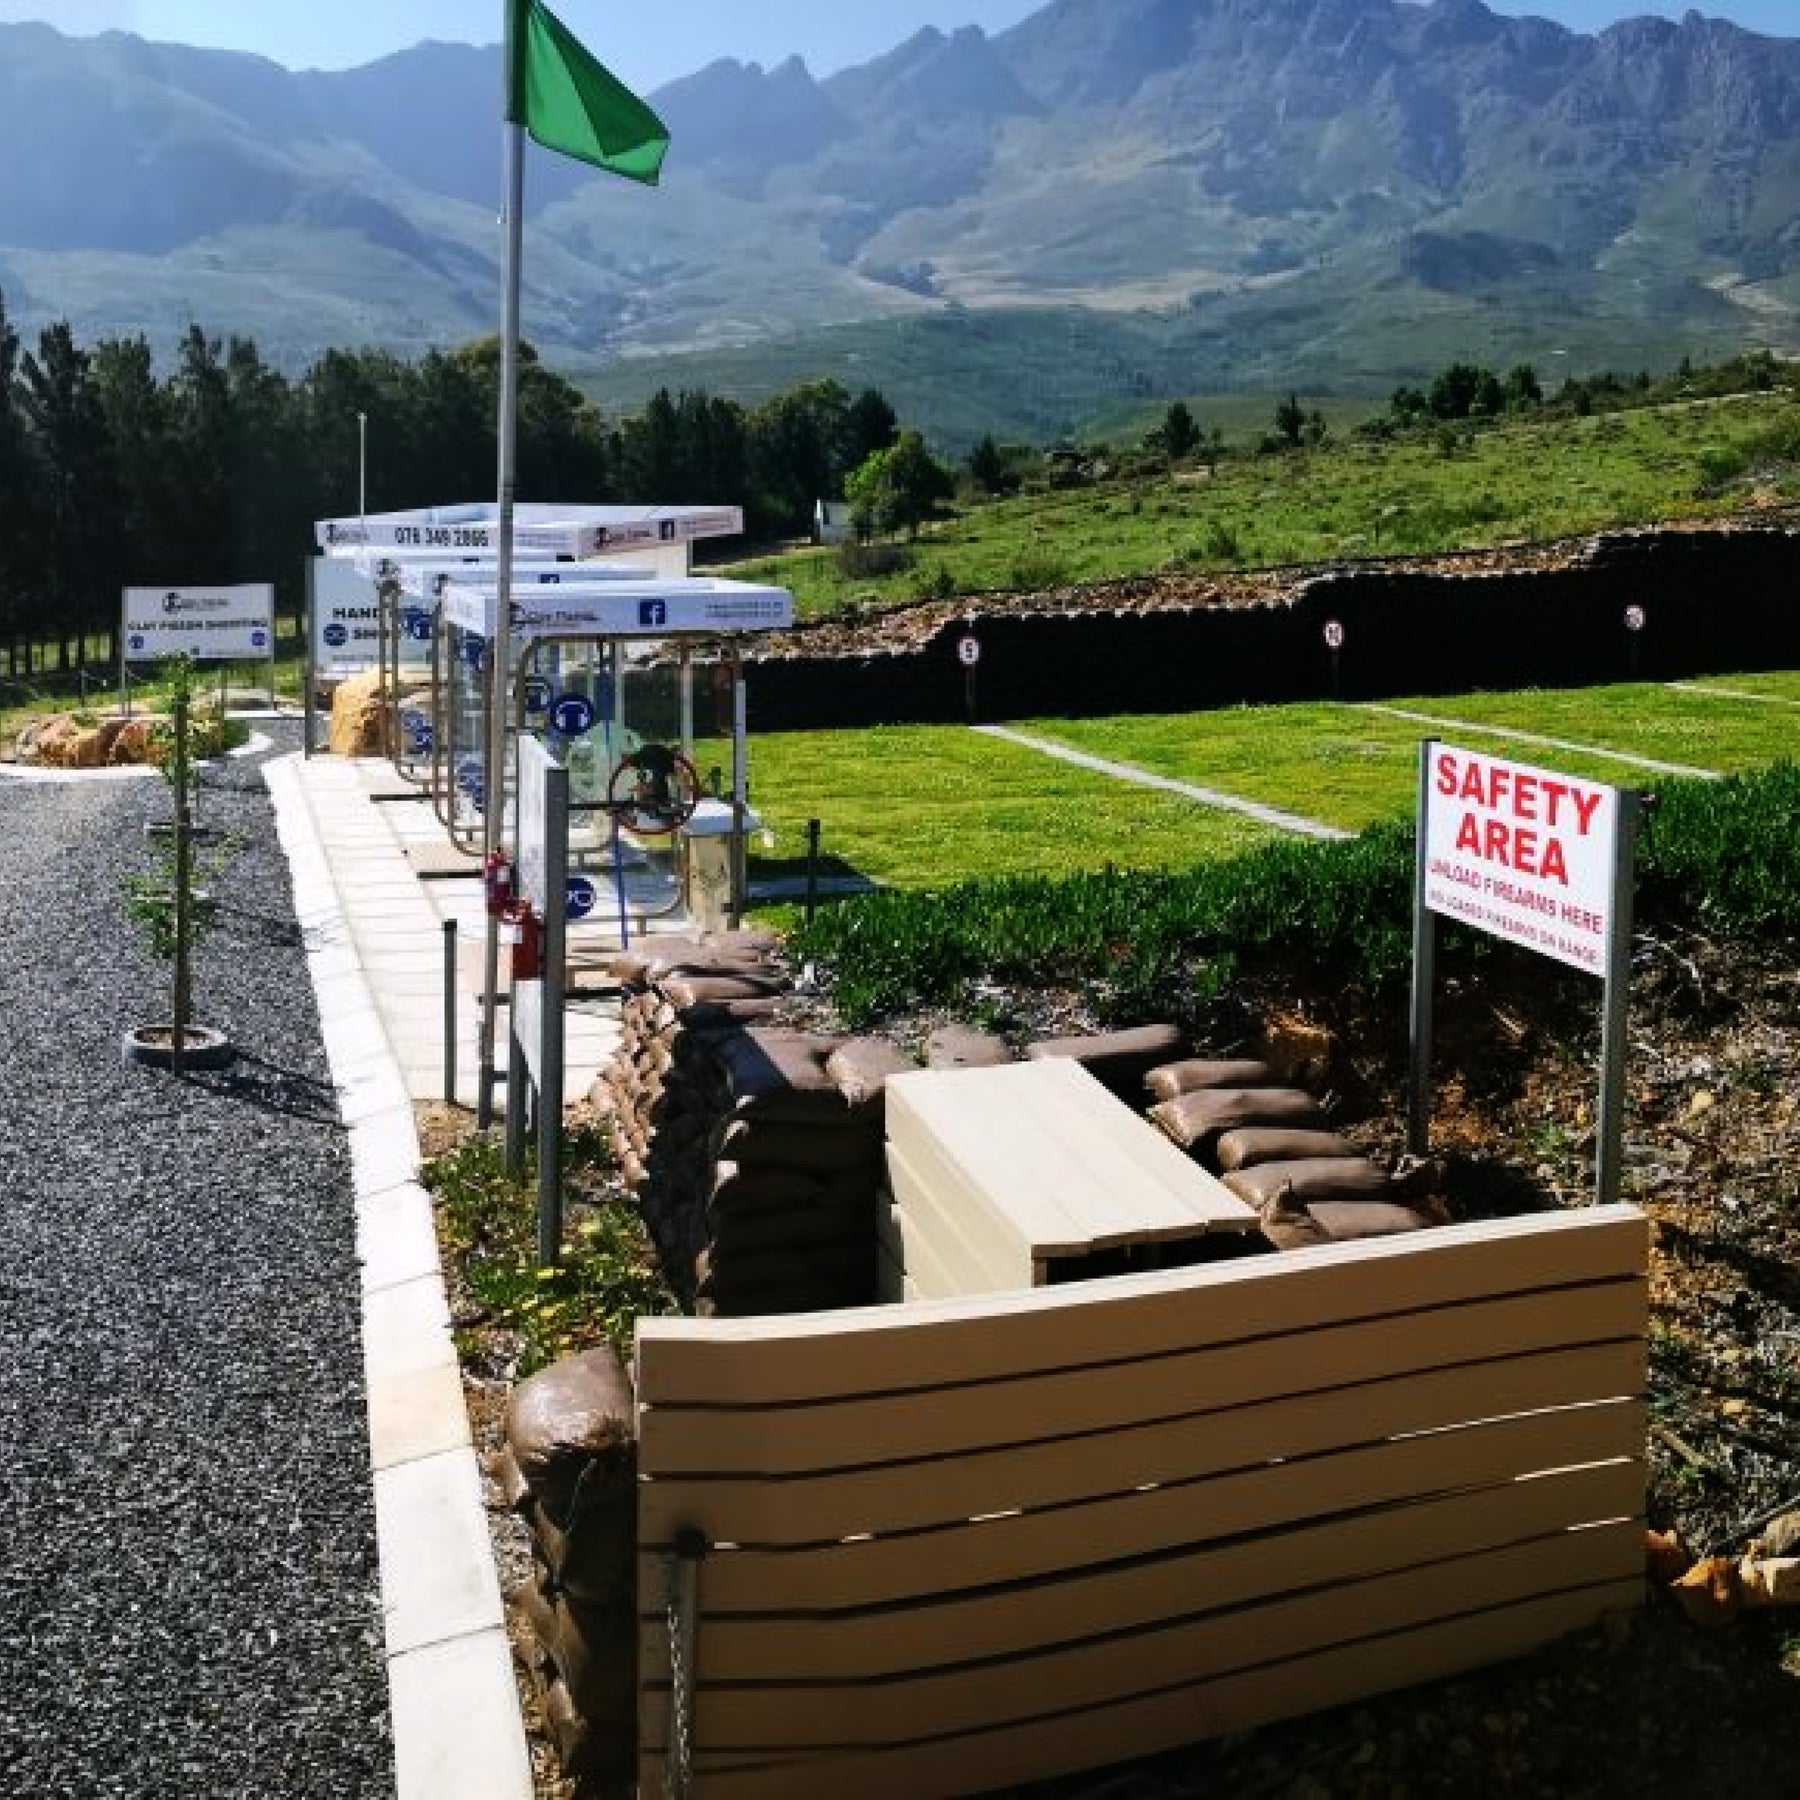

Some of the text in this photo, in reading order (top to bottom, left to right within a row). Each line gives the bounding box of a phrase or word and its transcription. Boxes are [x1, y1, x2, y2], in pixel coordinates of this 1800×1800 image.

[1436, 753, 1603, 835] SAFETY
[1455, 812, 1569, 888] AREA
[1484, 877, 1556, 917] FIREARMS
[1561, 902, 1603, 935] HERE
